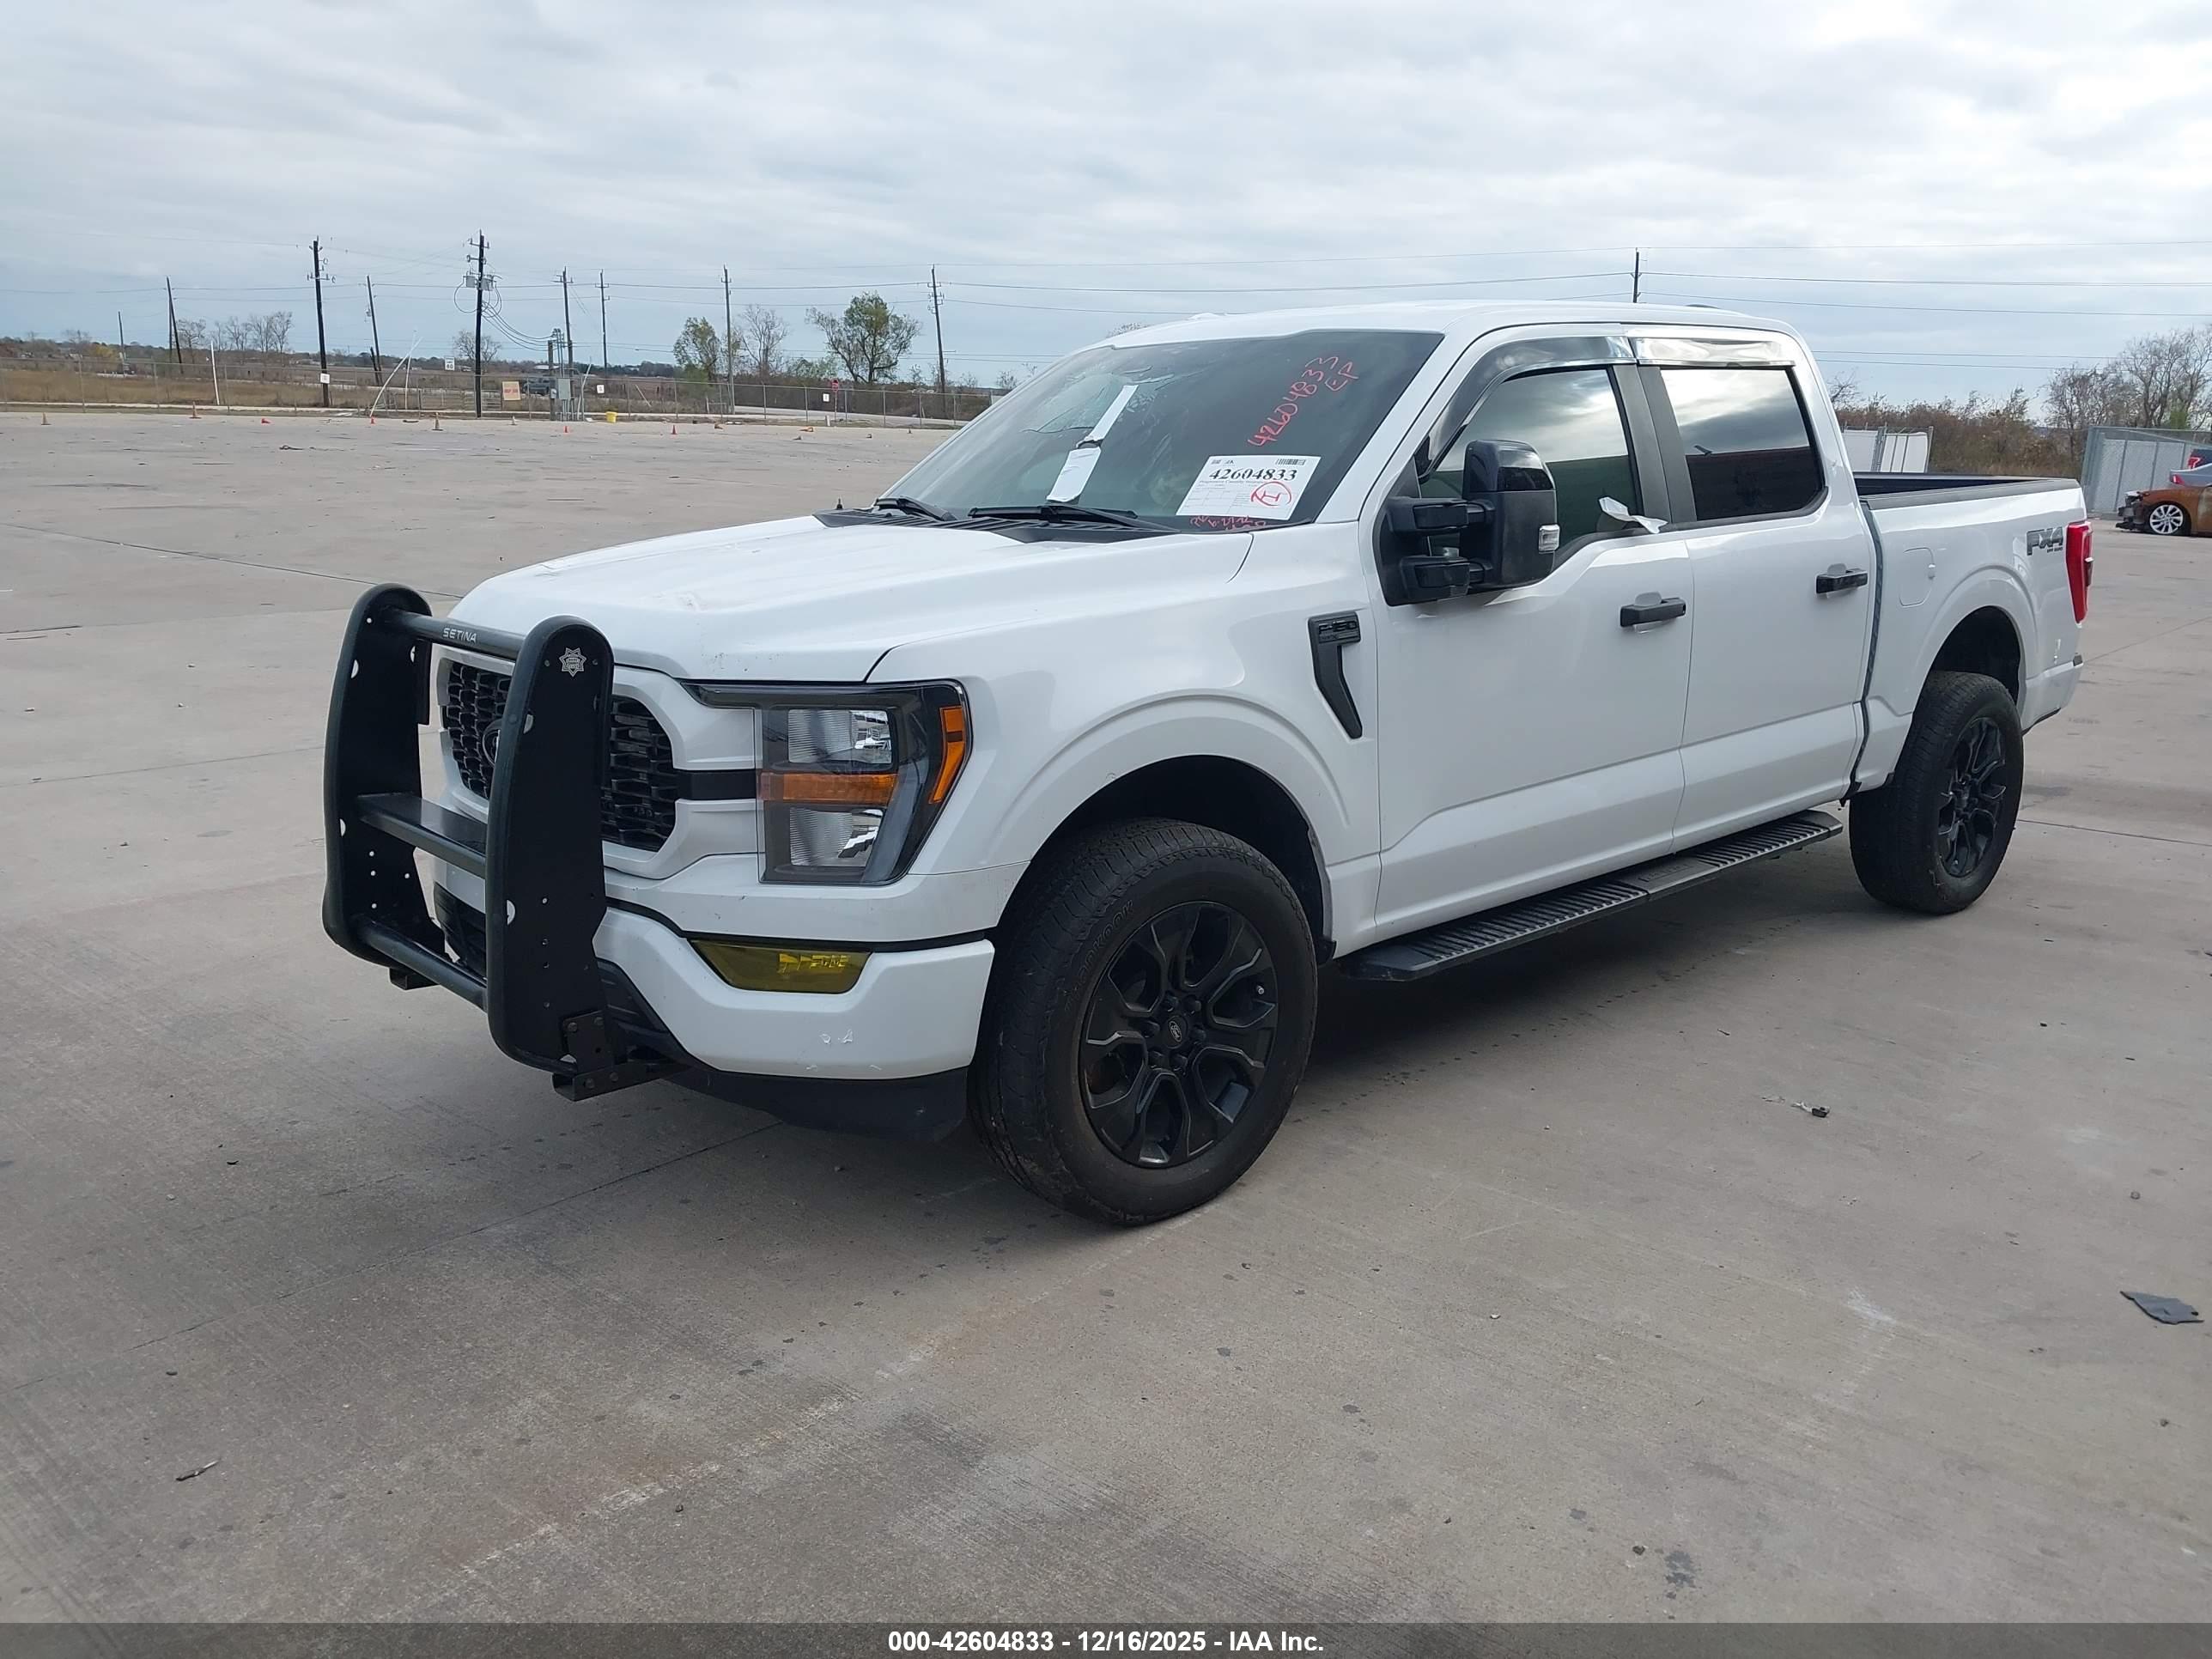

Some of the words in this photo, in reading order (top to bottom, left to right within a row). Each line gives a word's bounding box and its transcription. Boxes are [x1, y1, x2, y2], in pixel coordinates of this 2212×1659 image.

[1248, 356, 1339, 446] 42604833
[1209, 469, 1297, 481] 42604833
[2027, 526, 2063, 556] FX4
[443, 628, 477, 644] SETINA
